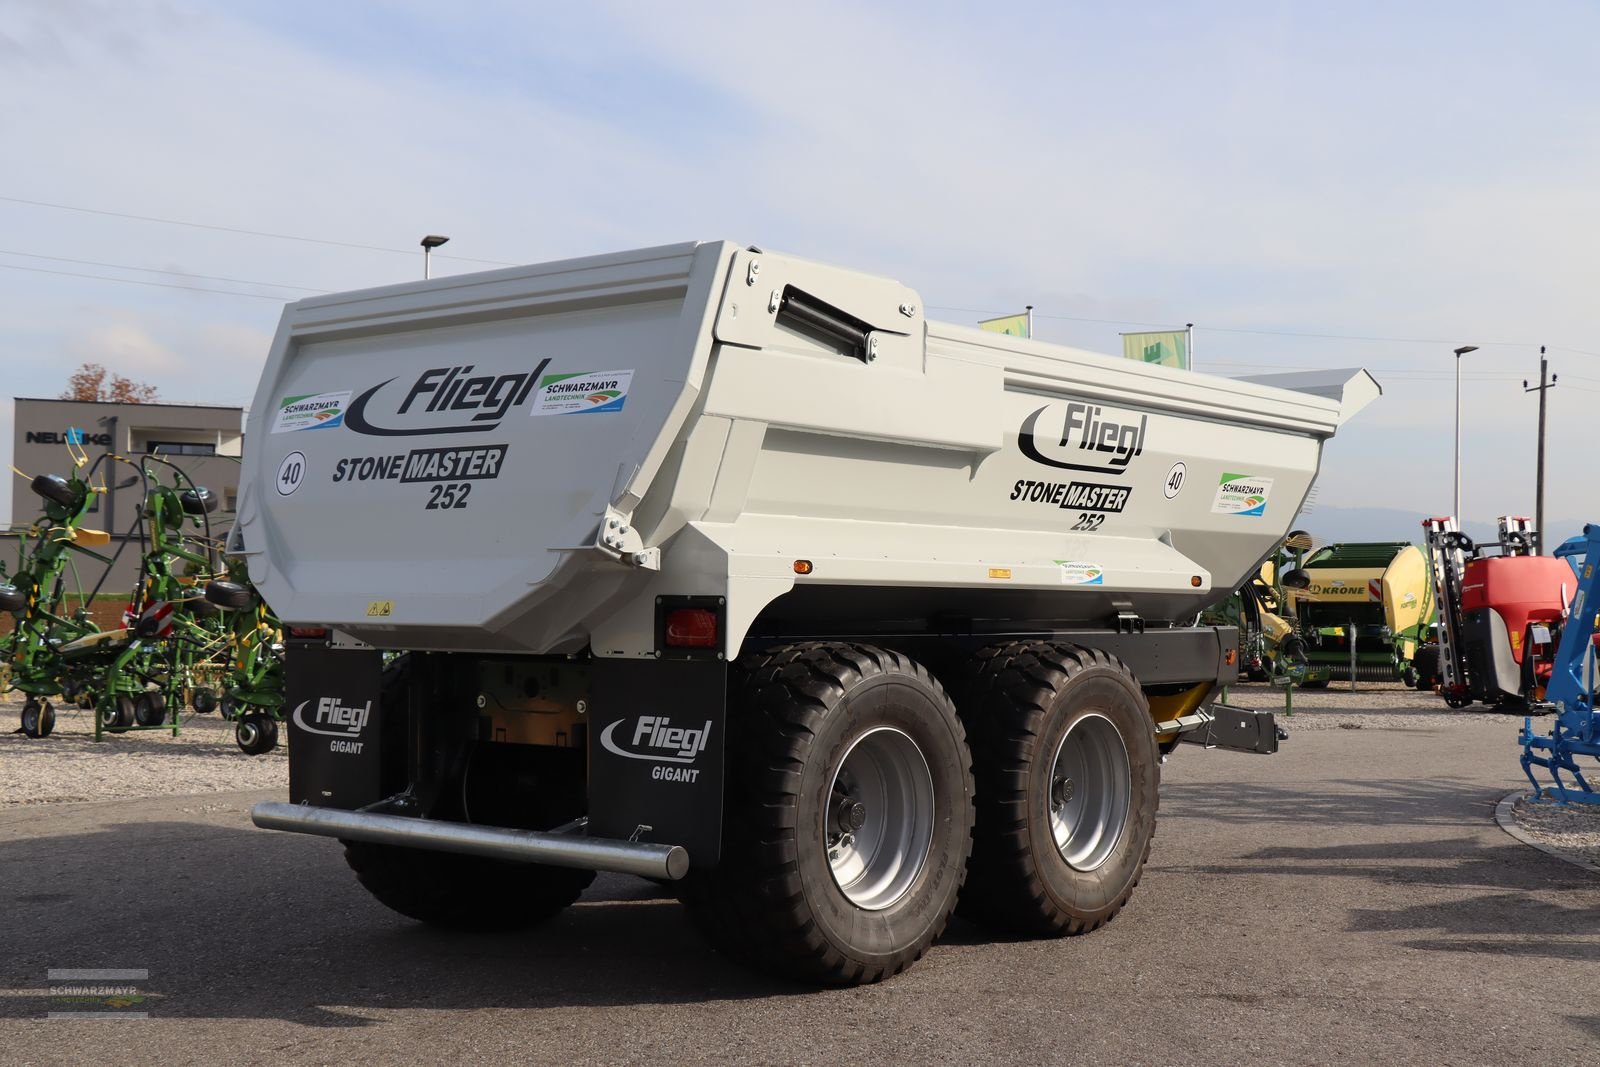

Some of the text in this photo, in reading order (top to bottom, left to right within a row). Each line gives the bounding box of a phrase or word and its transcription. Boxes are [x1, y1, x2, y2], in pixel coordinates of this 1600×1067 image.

[397, 358, 552, 421] Fliegl
[546, 380, 618, 394] SCHWARZMAYR
[544, 393, 586, 402] LANDTECHNIK
[284, 400, 340, 414] SCHWARZMAYR
[1059, 403, 1148, 466] Fliegl
[281, 463, 301, 485] 40
[1168, 472, 1183, 490] 40
[425, 483, 472, 510] 252
[1222, 483, 1264, 495] SCHWARZMAYR
[1070, 513, 1106, 532] 252
[1322, 586, 1366, 595] KRONE
[315, 697, 372, 732] Fliegl
[632, 715, 712, 758] Fliegl
[330, 740, 364, 754] GIGANT
[652, 766, 700, 783] GIGANT
